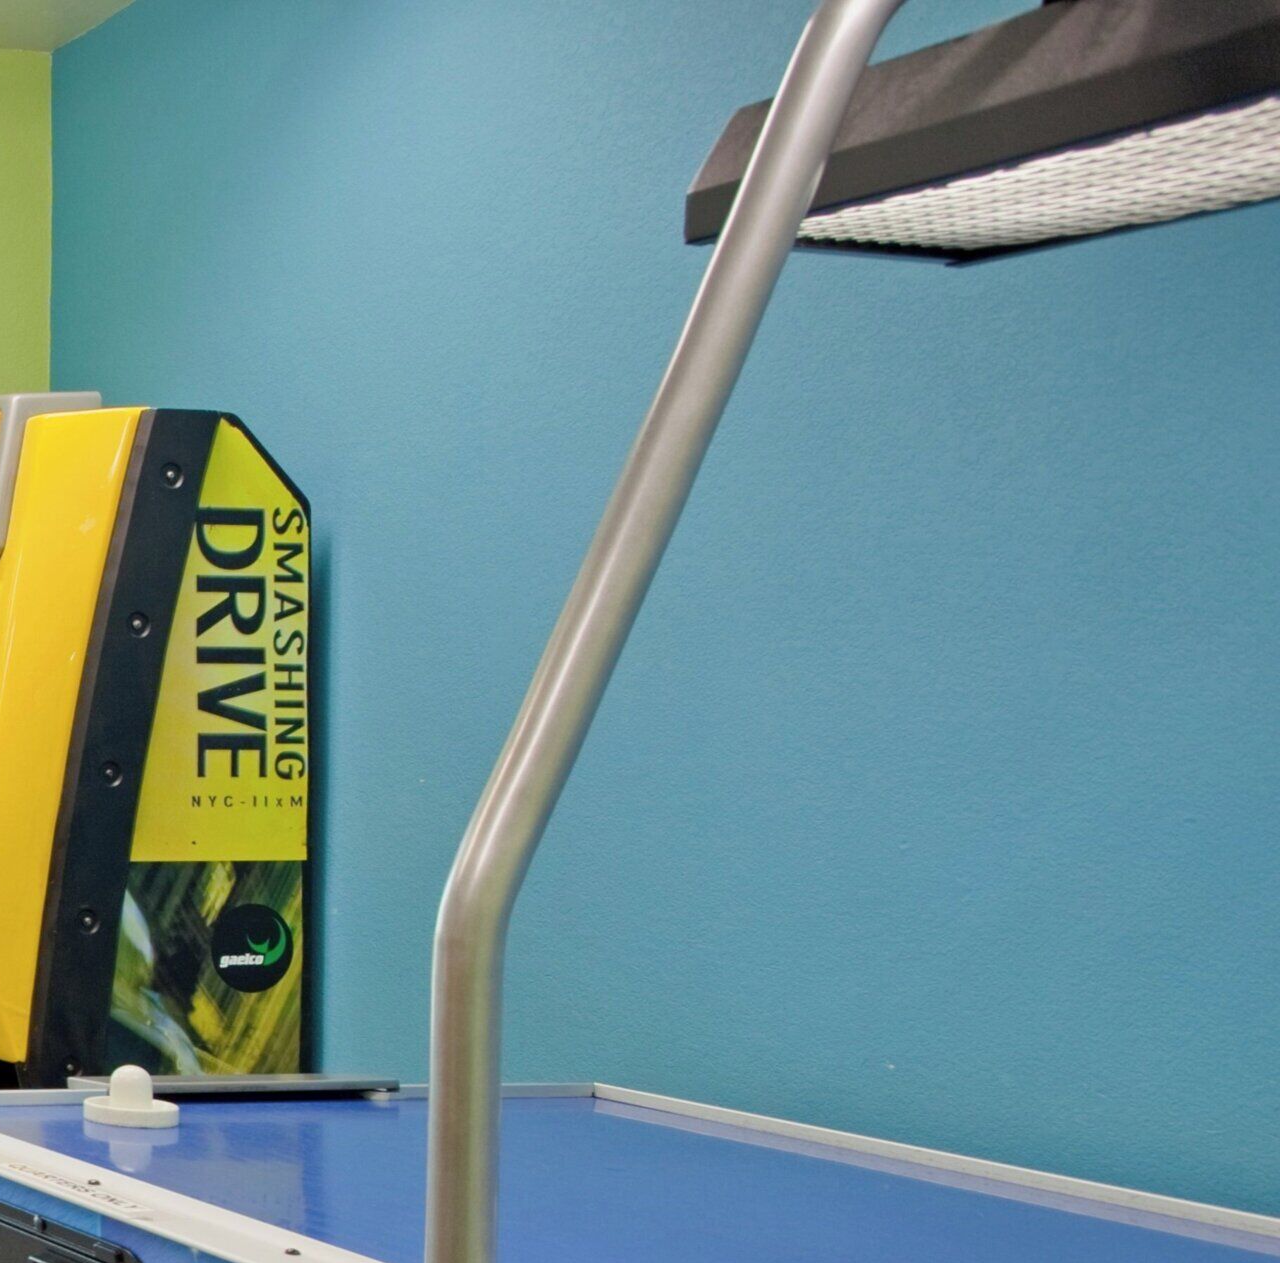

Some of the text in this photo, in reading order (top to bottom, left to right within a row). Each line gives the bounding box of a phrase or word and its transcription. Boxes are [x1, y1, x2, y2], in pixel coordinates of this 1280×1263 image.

[195, 507, 268, 779] DRIVE
[272, 507, 306, 781] SMASHING
[219, 953, 264, 968] gaelco
